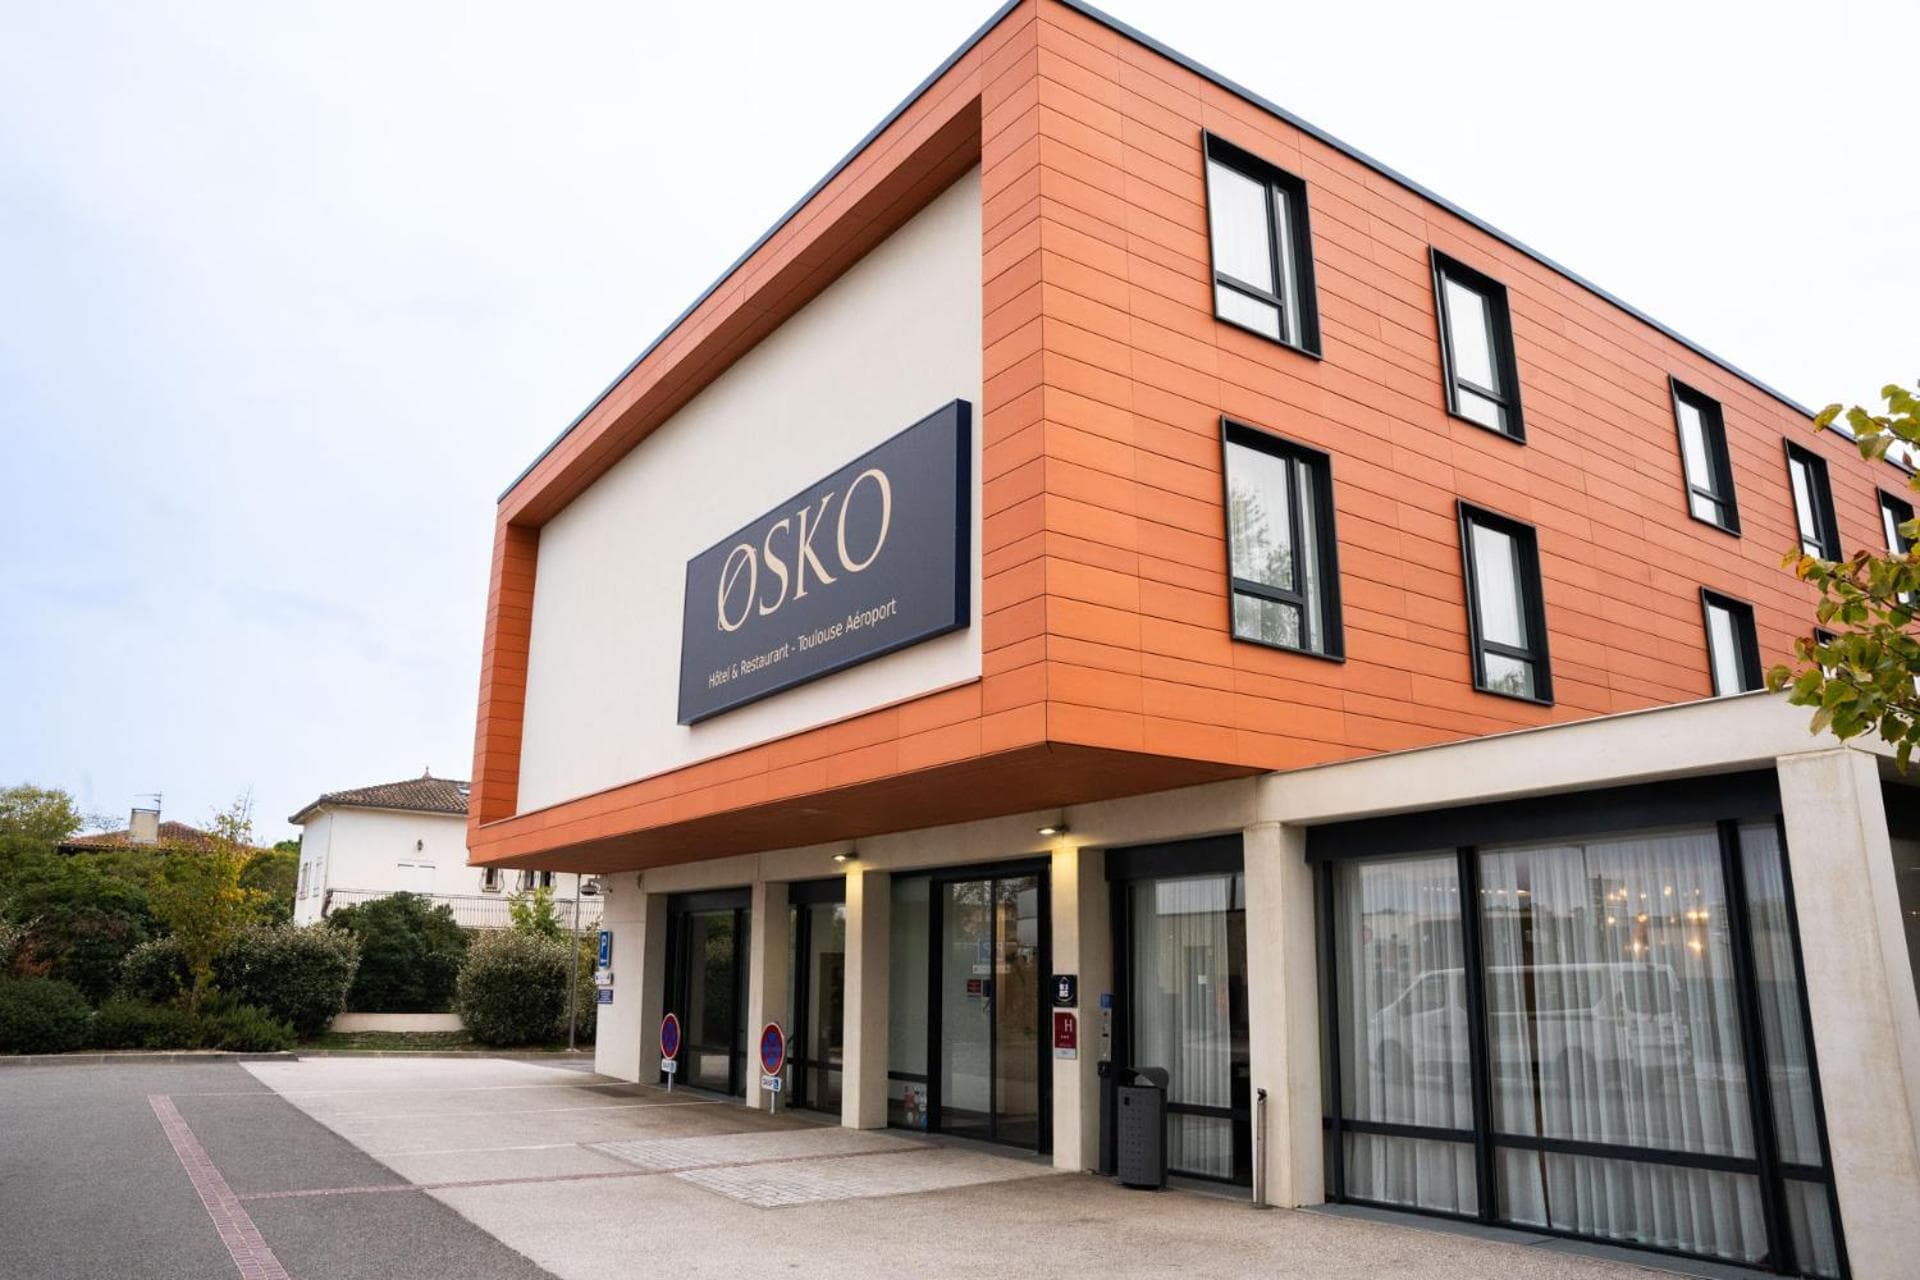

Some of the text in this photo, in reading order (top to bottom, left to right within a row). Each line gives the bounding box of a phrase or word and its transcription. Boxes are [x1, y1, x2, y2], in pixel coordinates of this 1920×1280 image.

[708, 671, 730, 689] Hôtel
[731, 665, 738, 679] &
[740, 645, 788, 673] Restaurant
[797, 621, 844, 652] Toulouse
[845, 599, 896, 633] Aéroport
[1064, 1019, 1072, 1032] H
